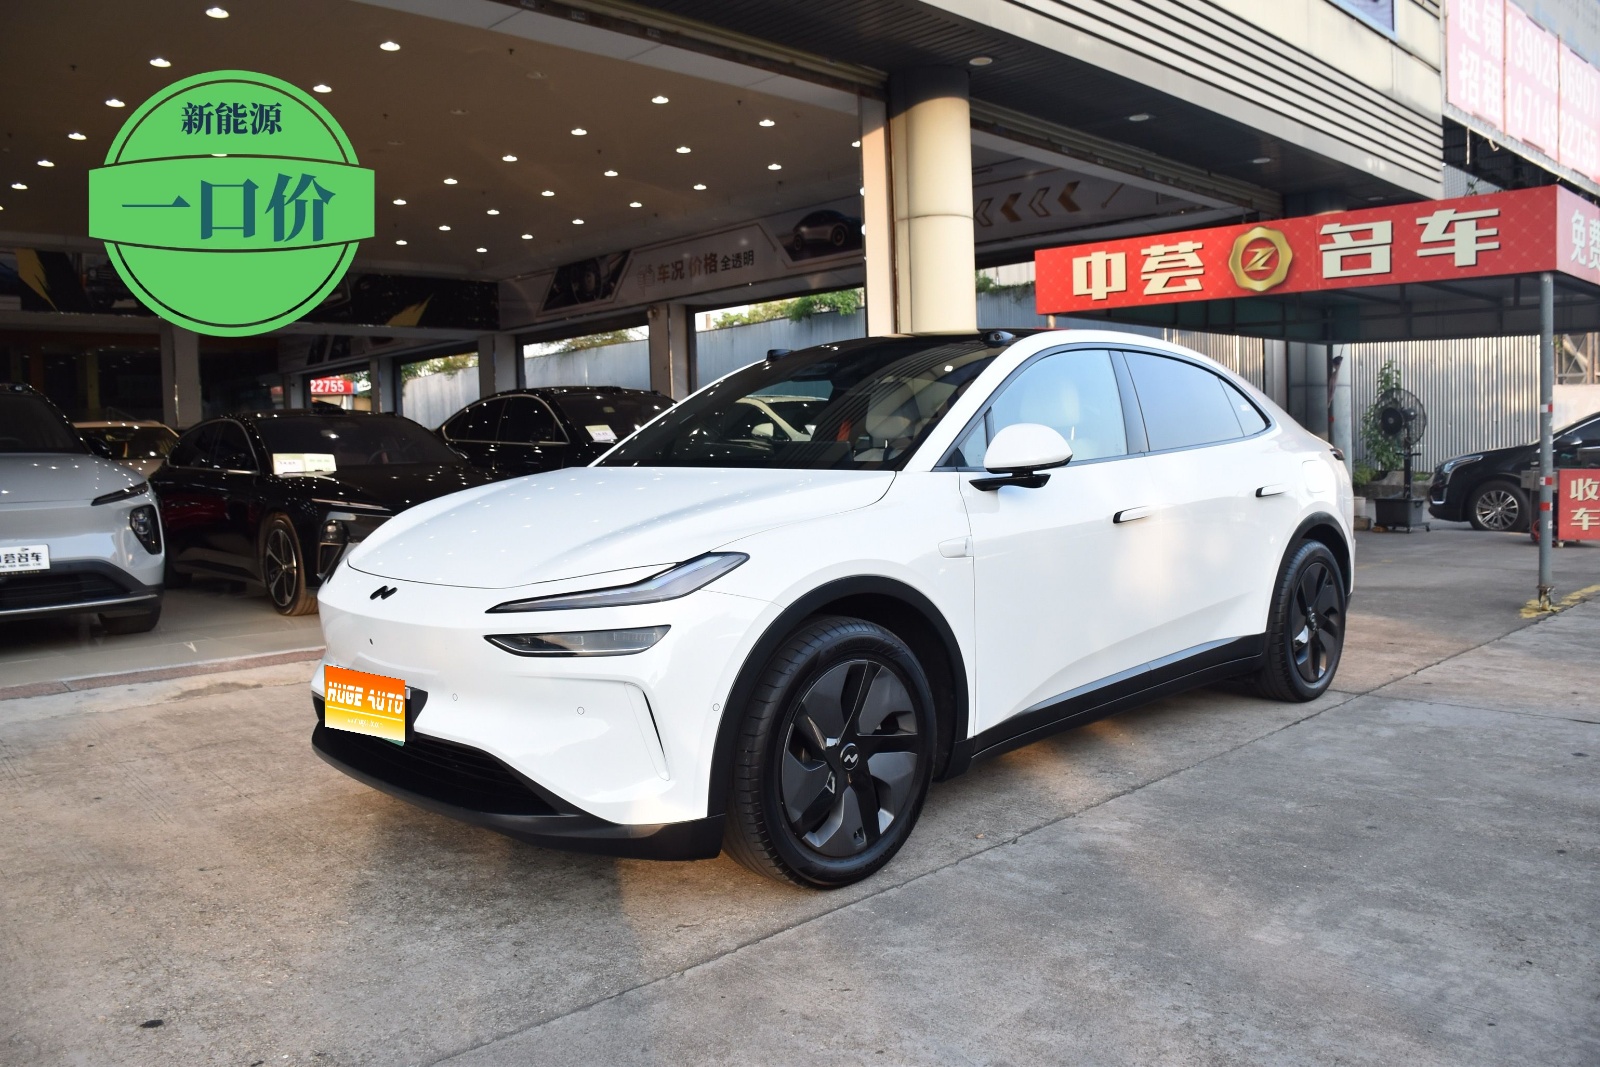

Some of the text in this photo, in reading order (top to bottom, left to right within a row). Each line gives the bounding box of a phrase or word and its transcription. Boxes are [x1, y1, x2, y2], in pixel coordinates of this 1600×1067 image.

[1459, 43, 1501, 119] 招租
[1072, 241, 1204, 300] 中荟
[1319, 208, 1500, 279] 名车
[1571, 208, 1600, 271] 免费
[310, 380, 345, 393] 22755
[0, 552, 42, 564] 荟名车
